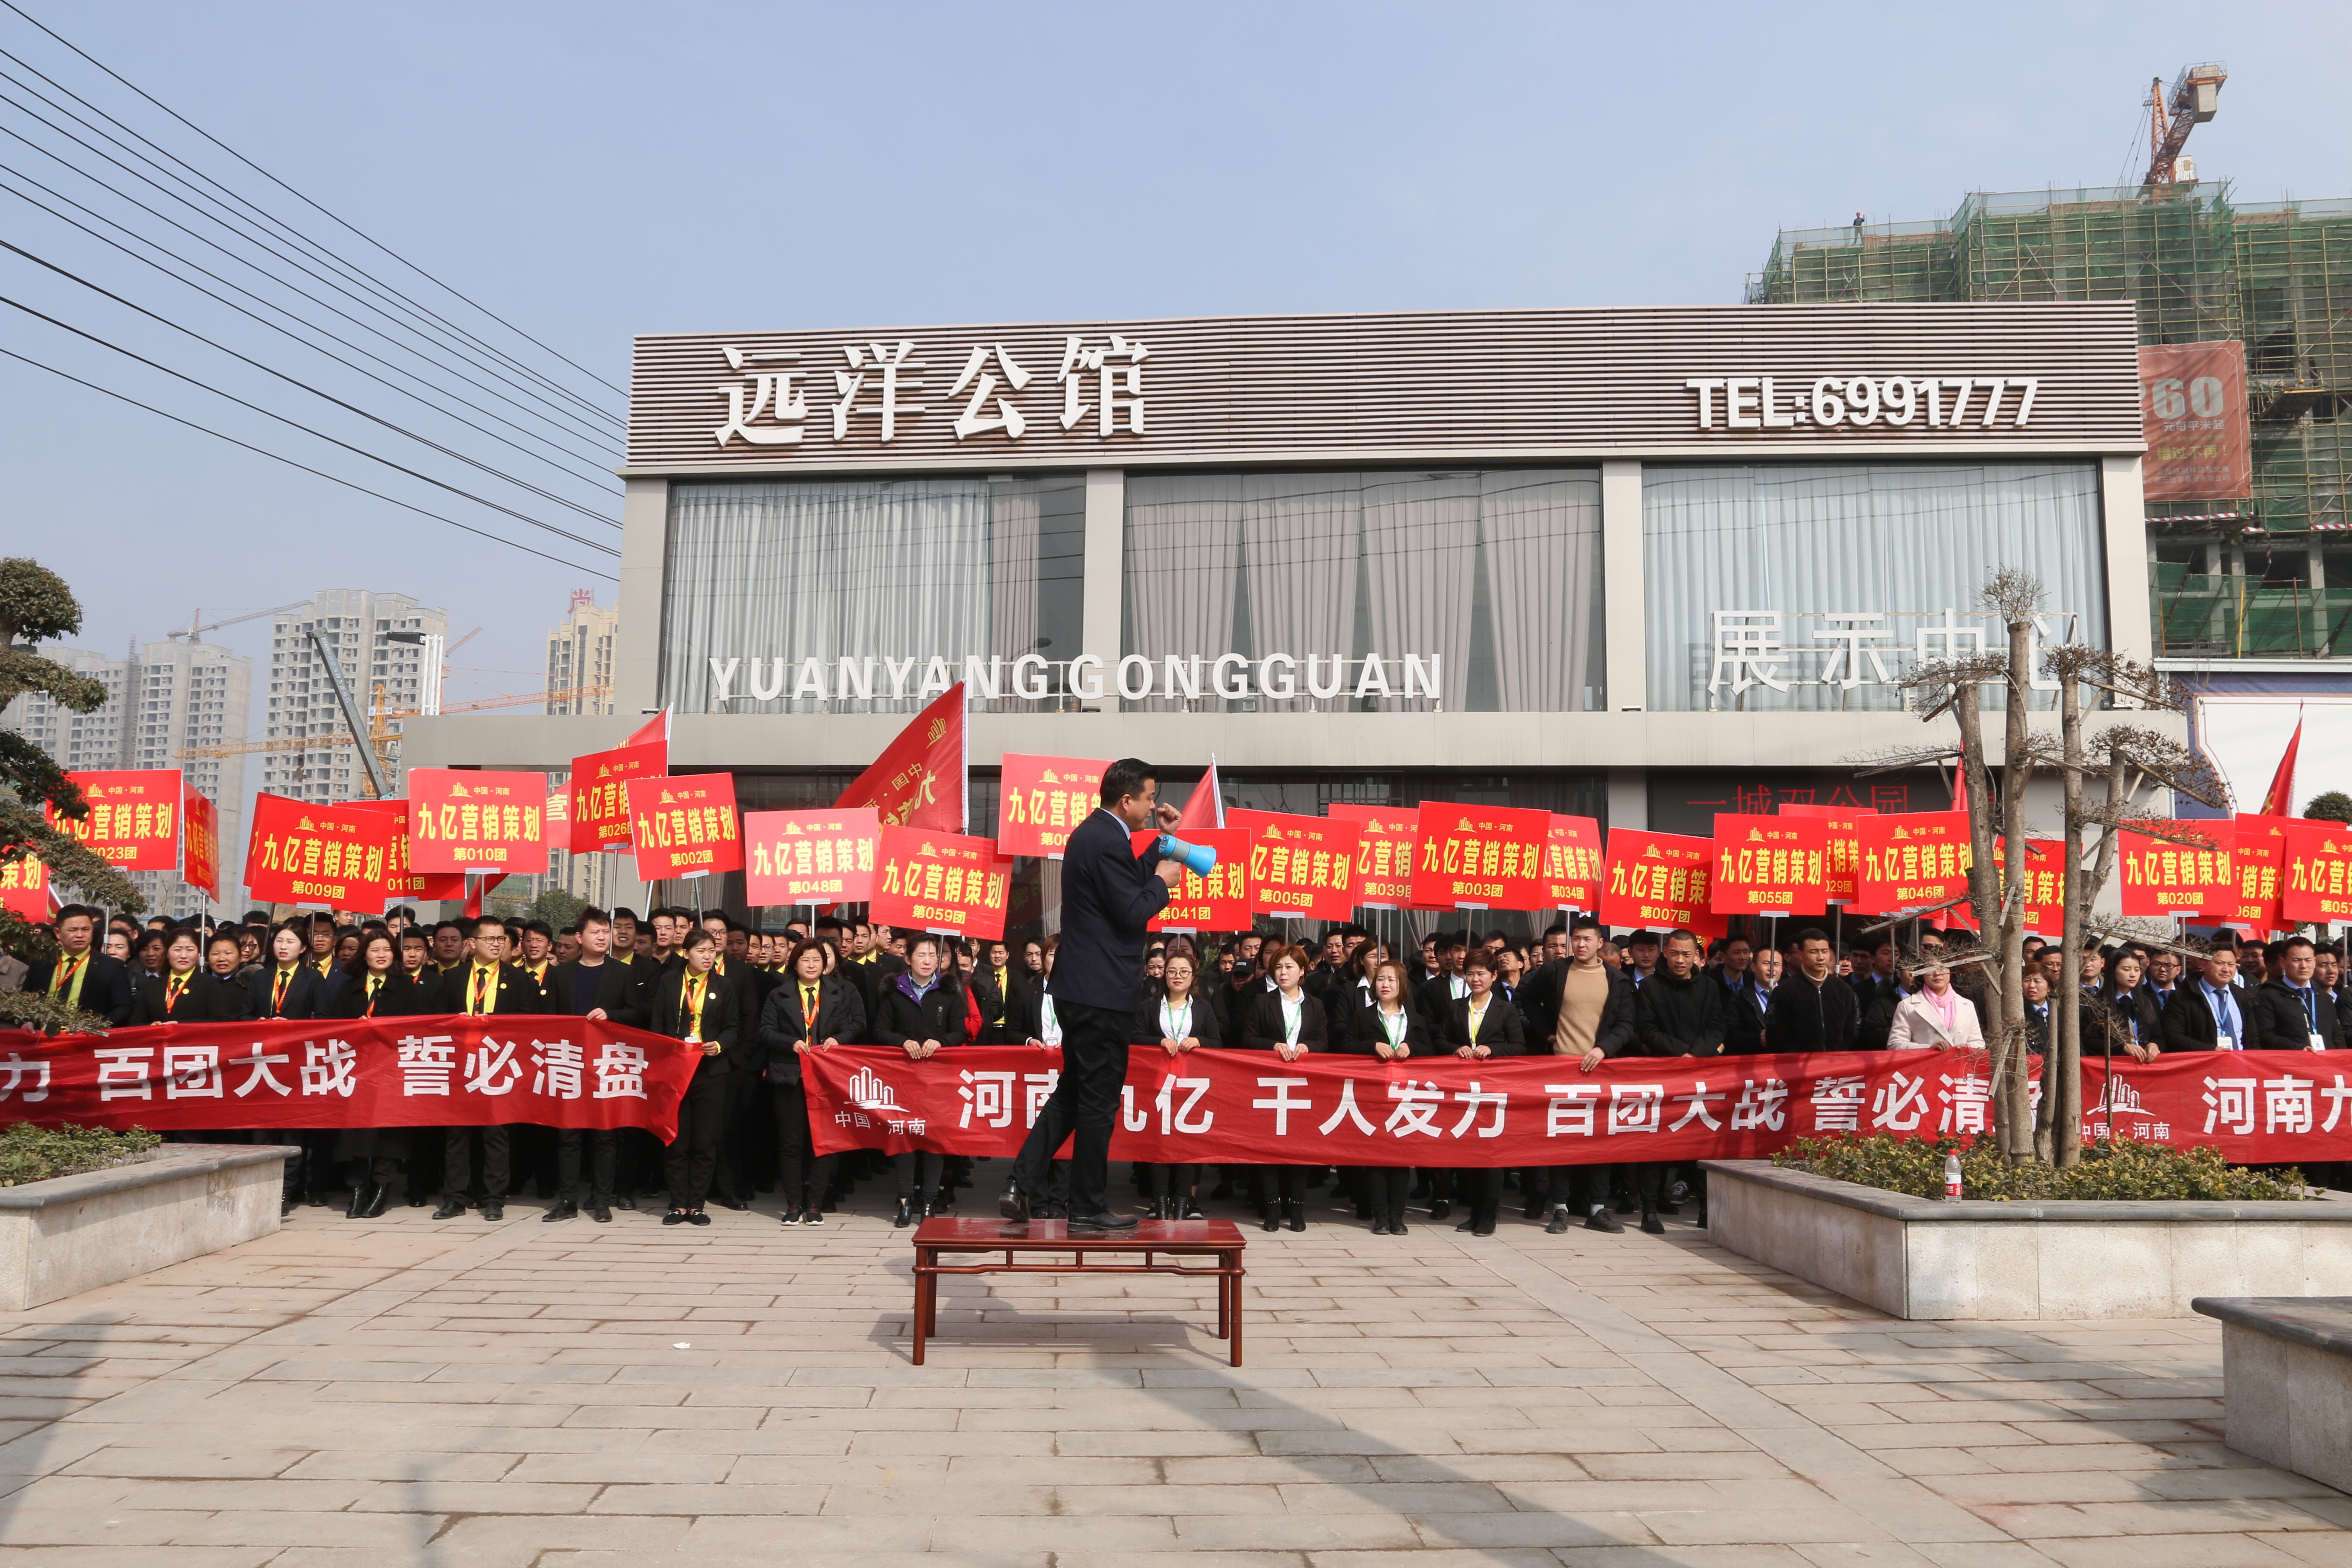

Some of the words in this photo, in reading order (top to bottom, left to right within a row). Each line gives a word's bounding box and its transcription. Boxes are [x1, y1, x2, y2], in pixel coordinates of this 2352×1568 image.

[715, 335, 1149, 447] 远洋公馆
[1686, 376, 2038, 429] TEL:6991777
[2163, 420, 2225, 432] 元每平米起
[709, 654, 1049, 701] YUANYANG
[1073, 652, 1440, 700] GONGGUAN
[418, 802, 539, 842] 九亿营销策划
[638, 805, 735, 849] 九亿营销策划
[261, 833, 384, 883] 九亿营销策划
[453, 847, 507, 861] 第010团
[670, 850, 714, 867] 第002团
[753, 838, 874, 876] 九亿营销策划
[1422, 836, 1540, 879] 九亿营销策划
[1720, 847, 1822, 885] 九亿营销策划
[2126, 851, 2231, 886] 九亿营销策划
[291, 880, 346, 900] 第009团
[788, 880, 842, 894] 第048团
[882, 858, 1004, 909] 九亿营销策划
[1452, 881, 1504, 897] 第003团
[1551, 885, 1584, 900] 第034团
[1611, 861, 1712, 905] 九亿营销策
[1896, 885, 1945, 901] 第046团
[1260, 888, 1313, 907] 第005团
[1748, 891, 1793, 904] 第055团
[2157, 892, 2204, 905] 第020团
[912, 905, 966, 925] 第059团
[1158, 906, 1211, 920] 第041团
[1640, 905, 1690, 924] 第007团
[0, 1053, 50, 1102] 力
[94, 1038, 357, 1102] 百团大战
[397, 1035, 649, 1100] 誓必清盘
[1544, 1078, 1788, 1137] 百团大战
[1810, 1070, 2043, 1134] 誓必清
